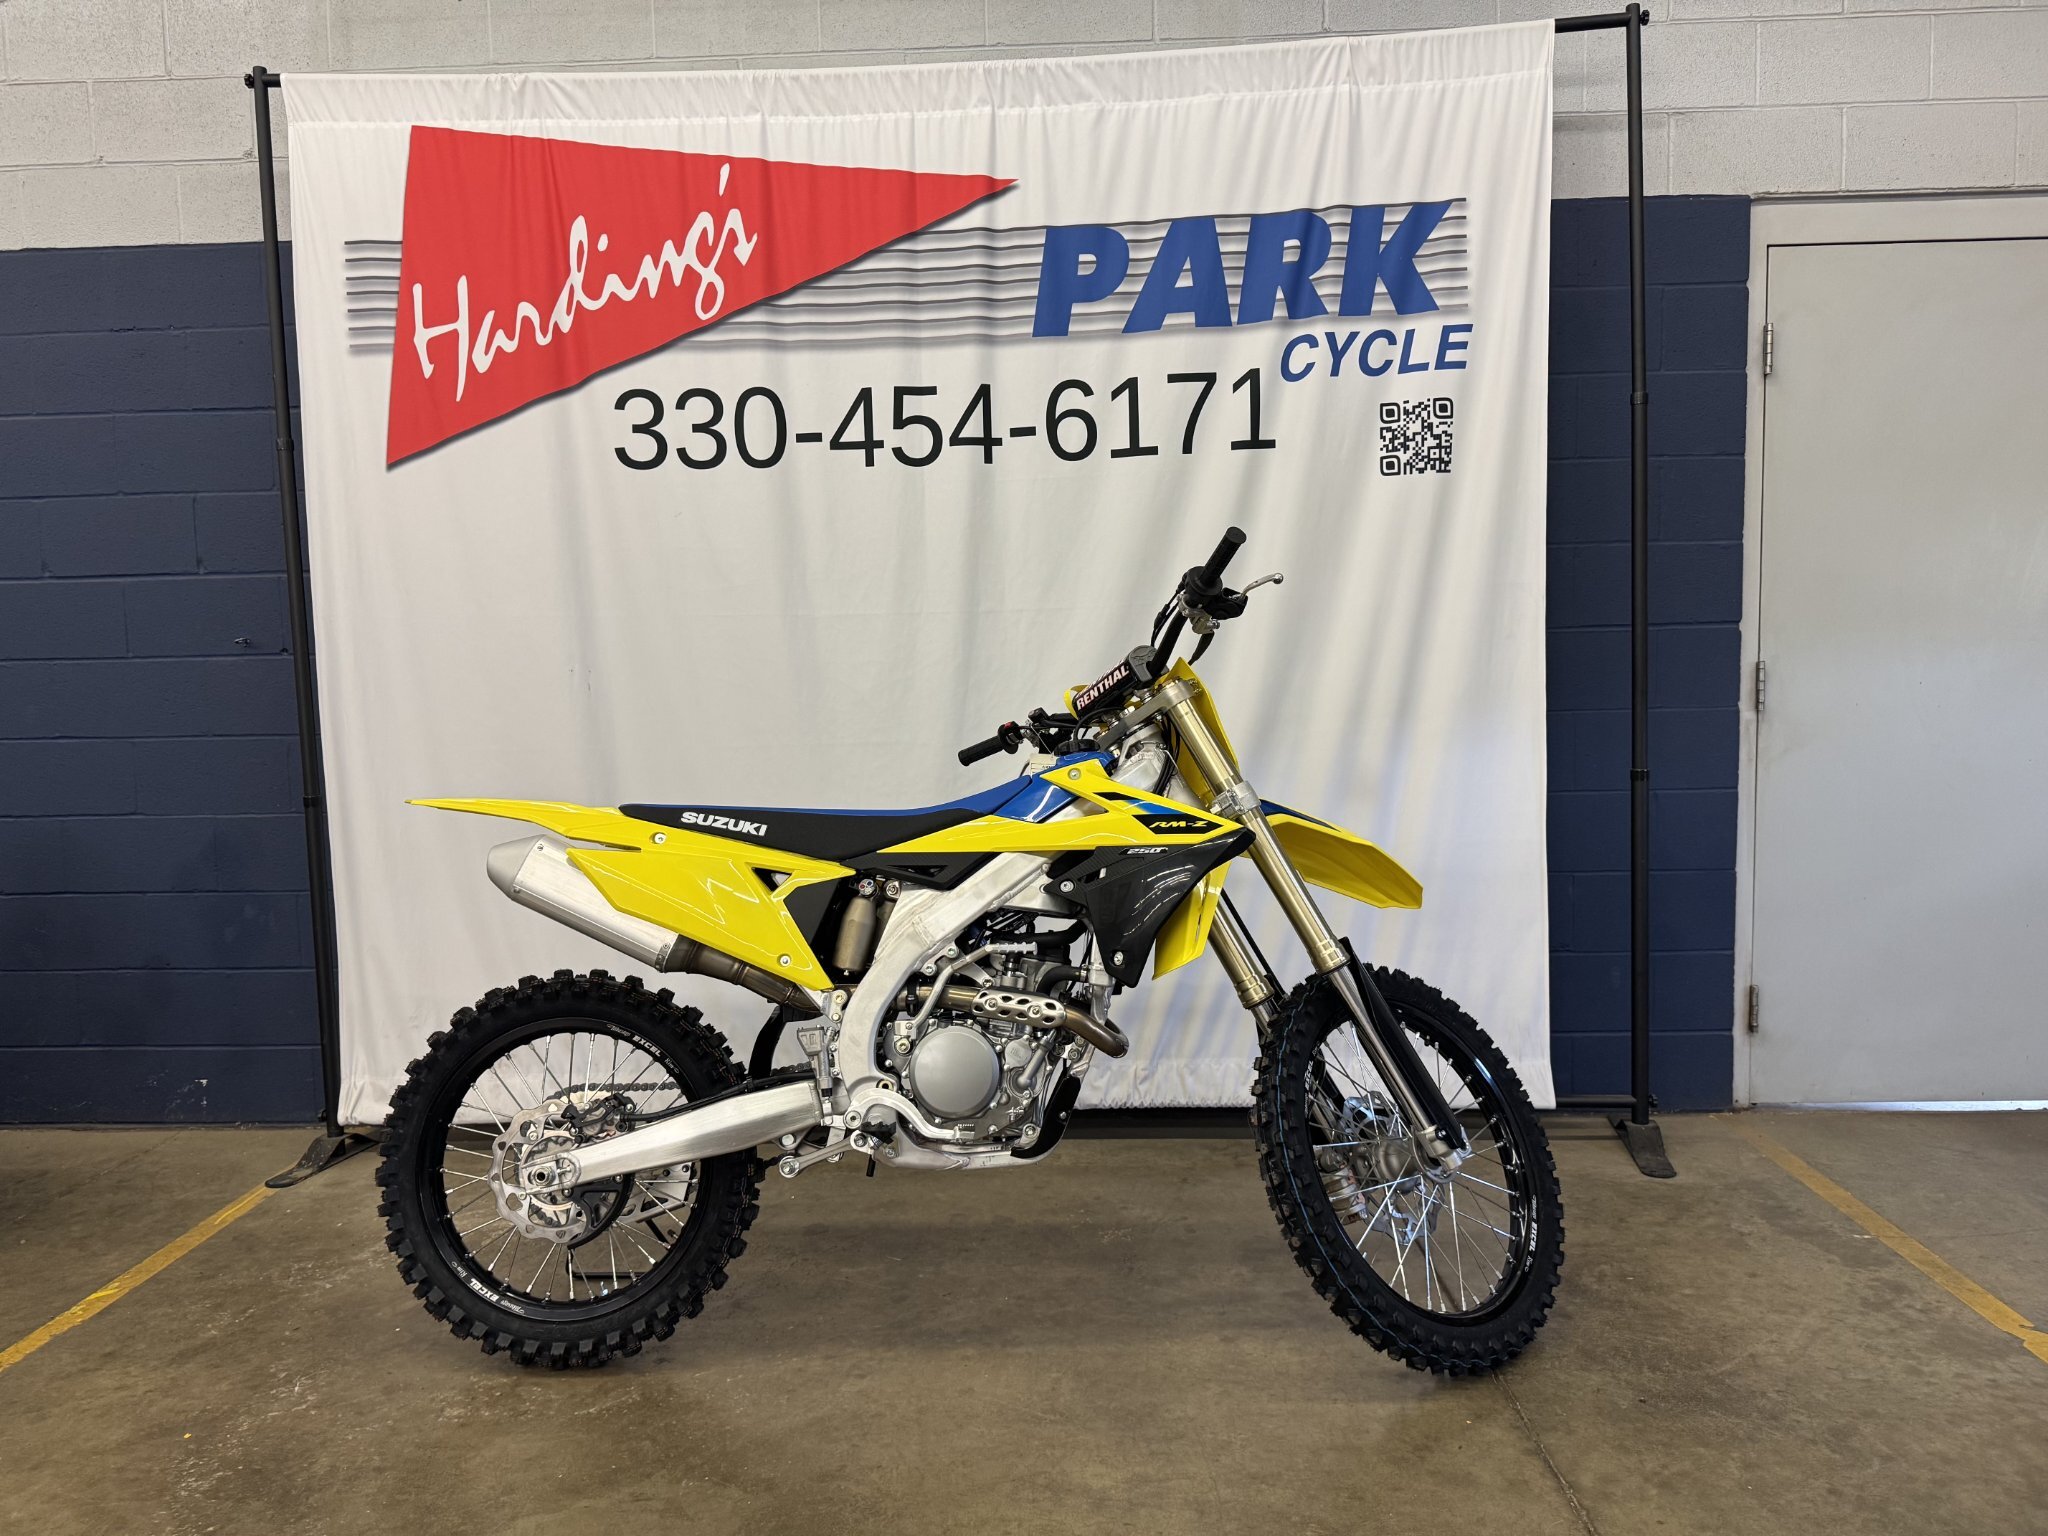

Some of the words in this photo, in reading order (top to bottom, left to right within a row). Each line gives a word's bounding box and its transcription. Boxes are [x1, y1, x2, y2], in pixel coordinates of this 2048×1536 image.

[412, 163, 757, 401] Harding's
[1032, 200, 1454, 337] PARK
[1280, 323, 1473, 382] CYCLE
[613, 367, 1276, 471] 330-454-6171
[1076, 664, 1130, 711] RENTHAL
[680, 811, 768, 837] SUZUKI
[1149, 820, 1208, 828] RM-Z
[632, 1035, 661, 1057] EXCEL
[469, 1278, 500, 1303] EXCEL
